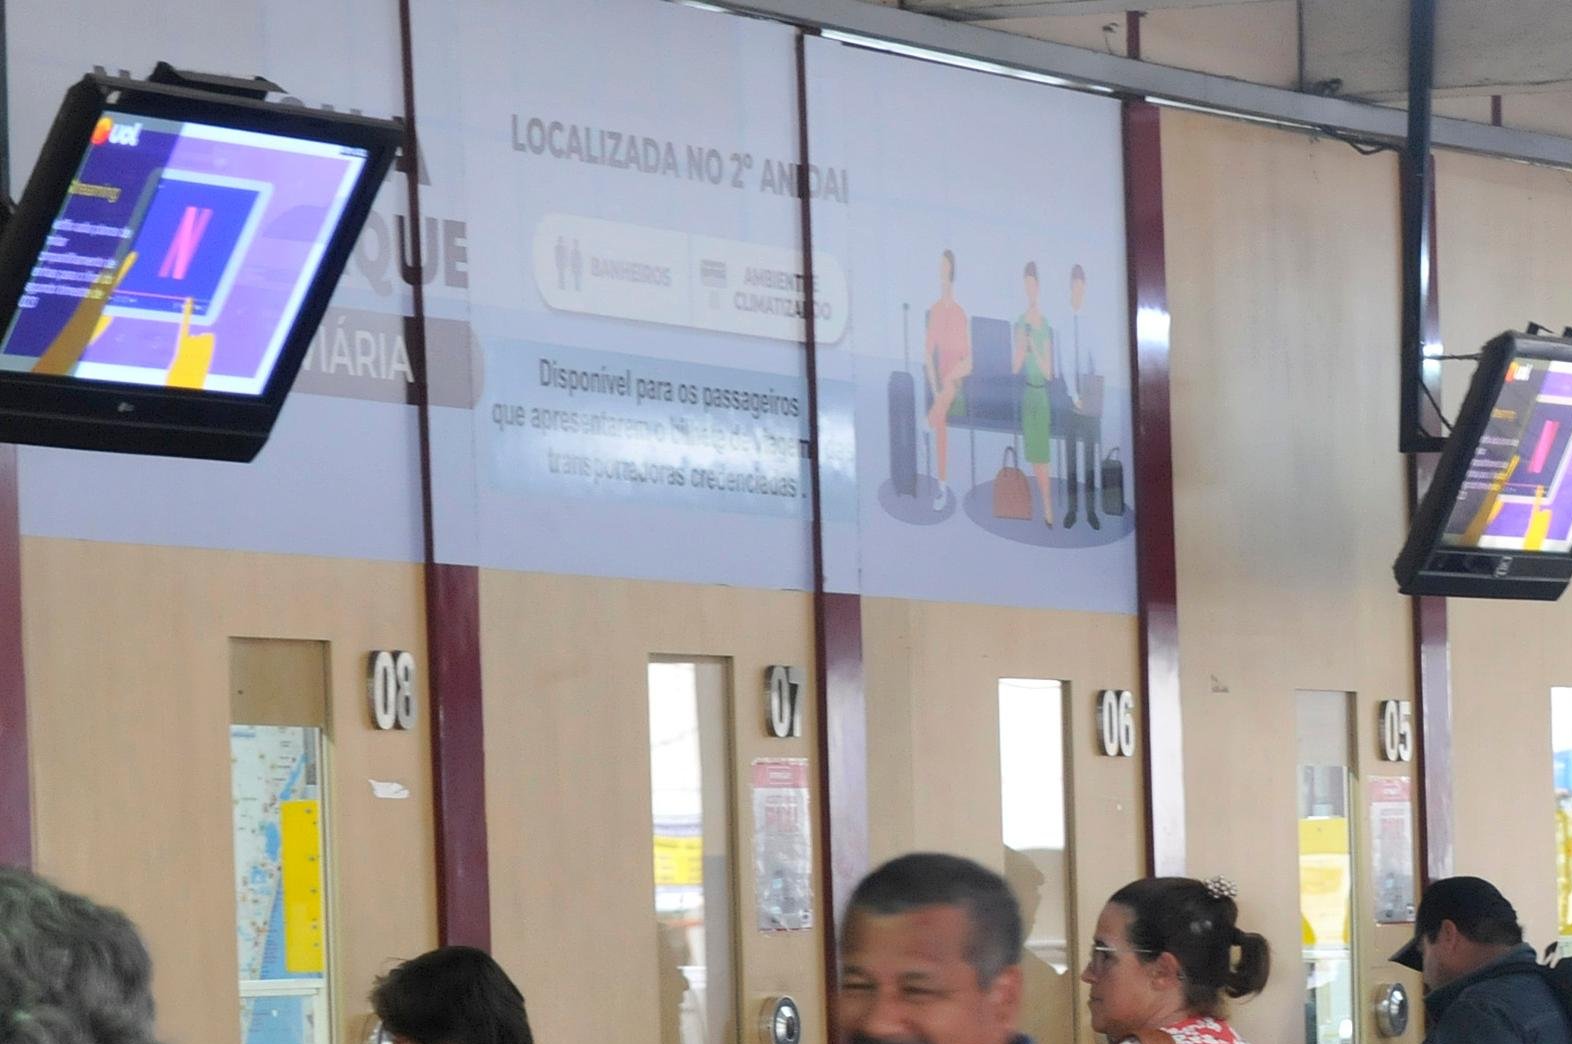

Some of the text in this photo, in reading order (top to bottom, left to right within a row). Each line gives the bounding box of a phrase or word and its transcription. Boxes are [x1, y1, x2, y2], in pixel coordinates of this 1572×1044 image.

[512, 113, 680, 178] LOCALIZADA
[687, 144, 723, 186] NO
[590, 256, 672, 287] BANHEIROS
[491, 401, 526, 431] que
[538, 358, 800, 420] Disponível para os passageiros
[370, 650, 418, 730] 08
[768, 664, 807, 738] 07
[1100, 690, 1136, 757] 06
[1382, 700, 1413, 762] 05
